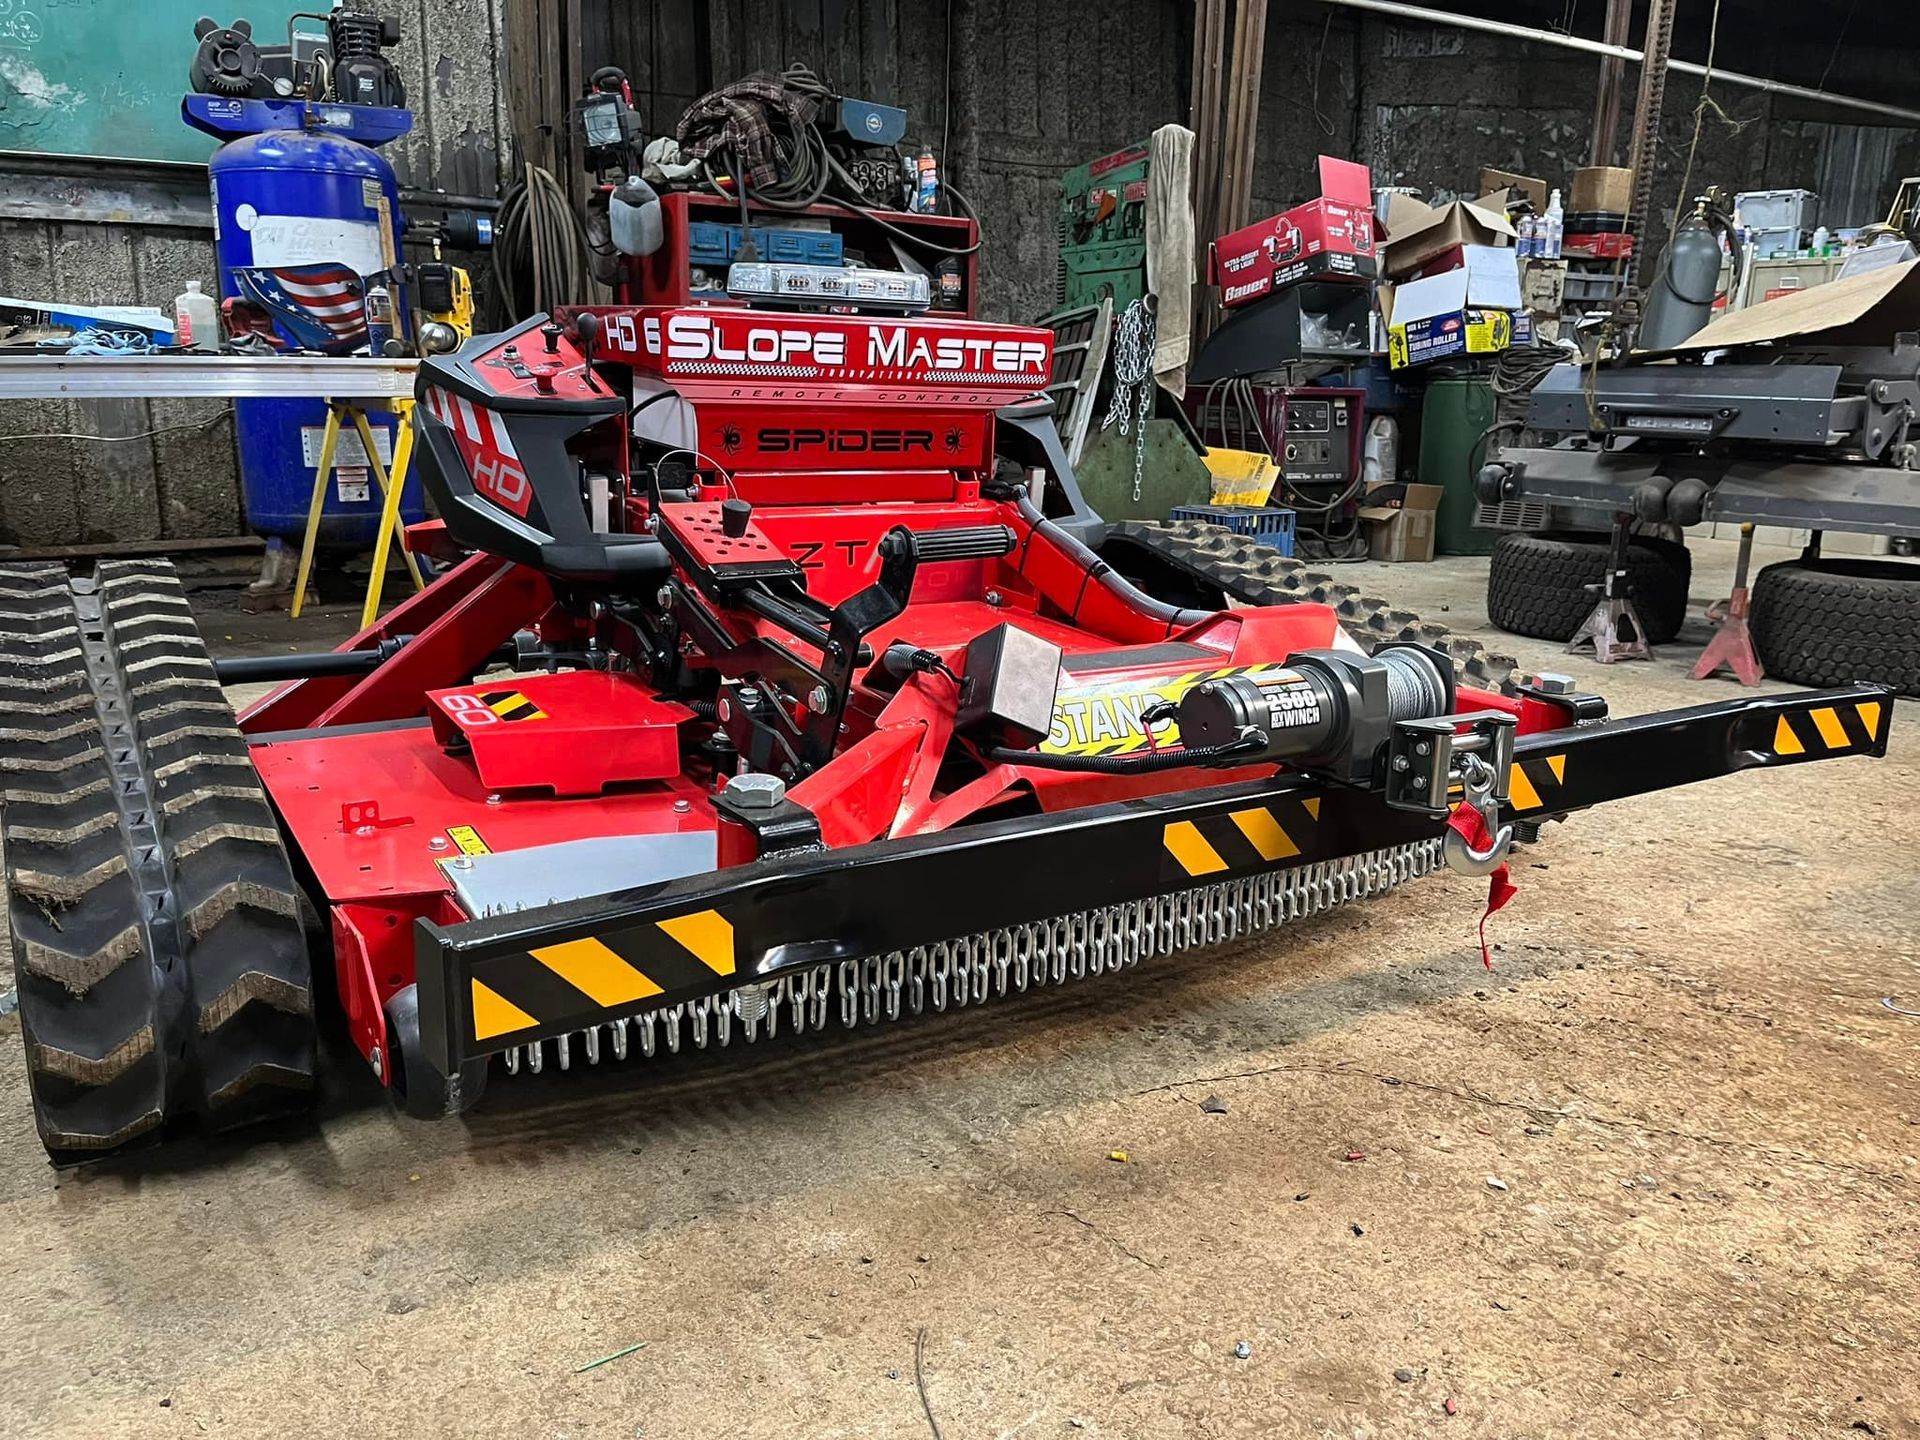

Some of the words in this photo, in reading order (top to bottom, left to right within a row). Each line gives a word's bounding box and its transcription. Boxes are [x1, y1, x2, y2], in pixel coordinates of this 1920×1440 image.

[1225, 277, 1269, 302] Bauer
[604, 315, 637, 352] HD
[1433, 332, 1458, 346] ROLLER
[731, 388, 844, 399] REMOTE
[878, 393, 994, 403] CONTROL
[473, 452, 527, 502] HD
[441, 694, 498, 726] 60
[1265, 689, 1317, 712] 2500
[1283, 706, 1320, 727] WINCH
